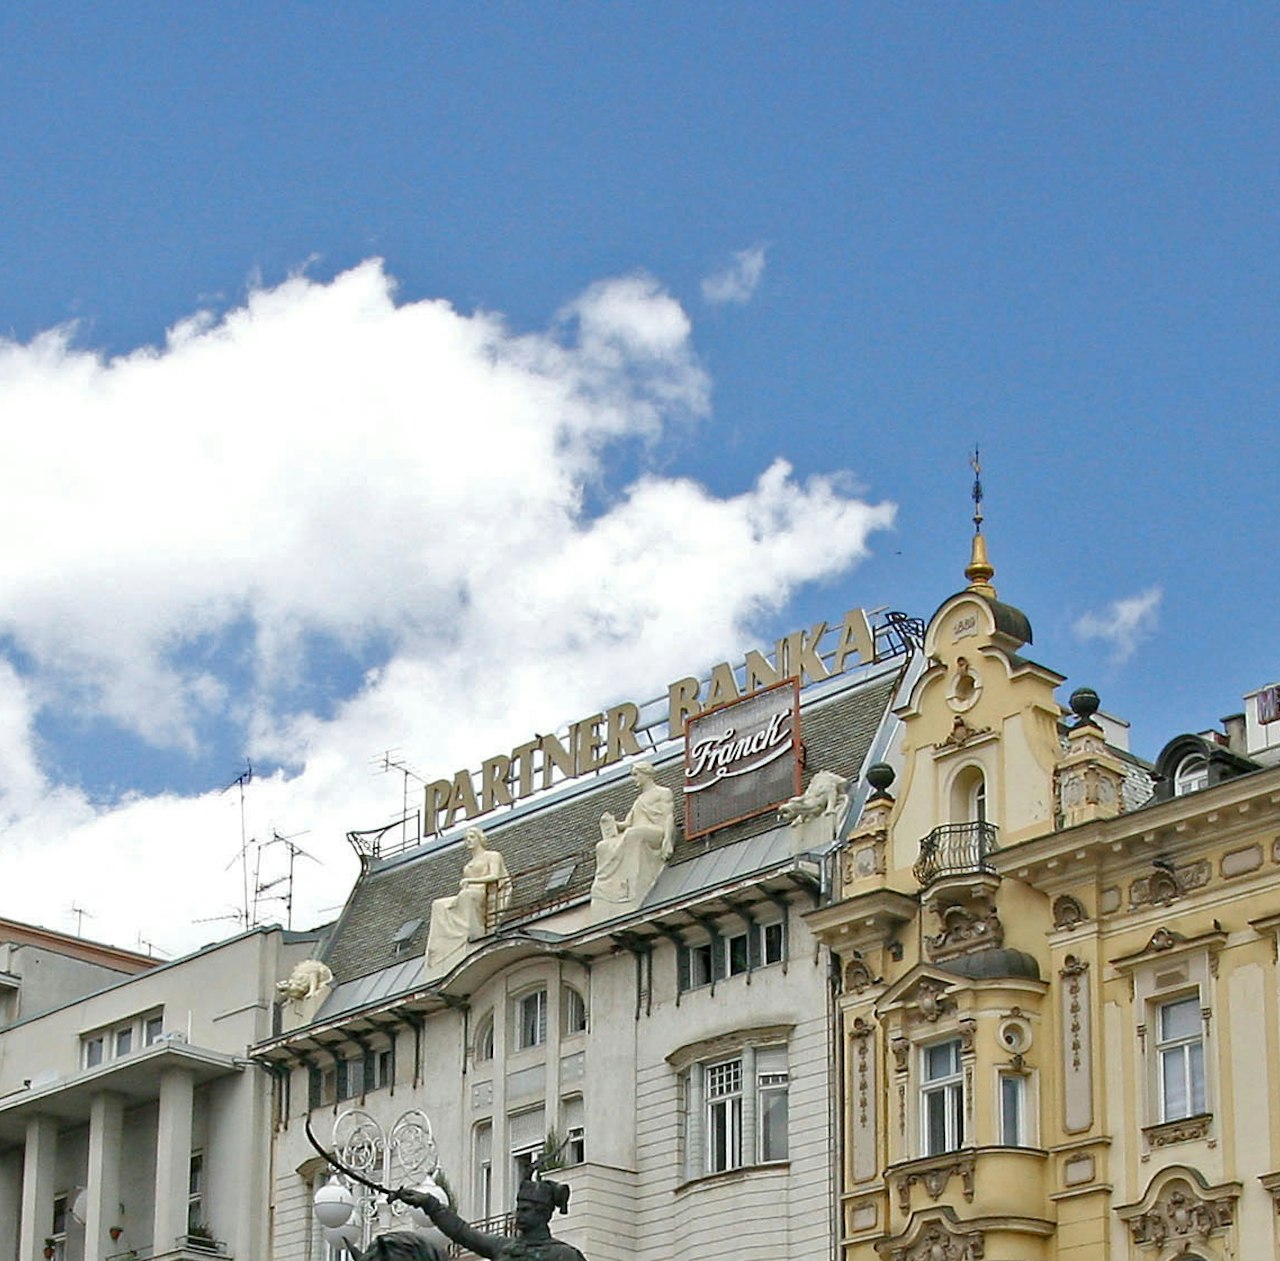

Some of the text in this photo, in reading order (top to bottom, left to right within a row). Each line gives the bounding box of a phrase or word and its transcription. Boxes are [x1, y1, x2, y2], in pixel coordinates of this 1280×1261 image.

[423, 607, 876, 838] PARTNER BANKA
[684, 707, 793, 779] Franck
